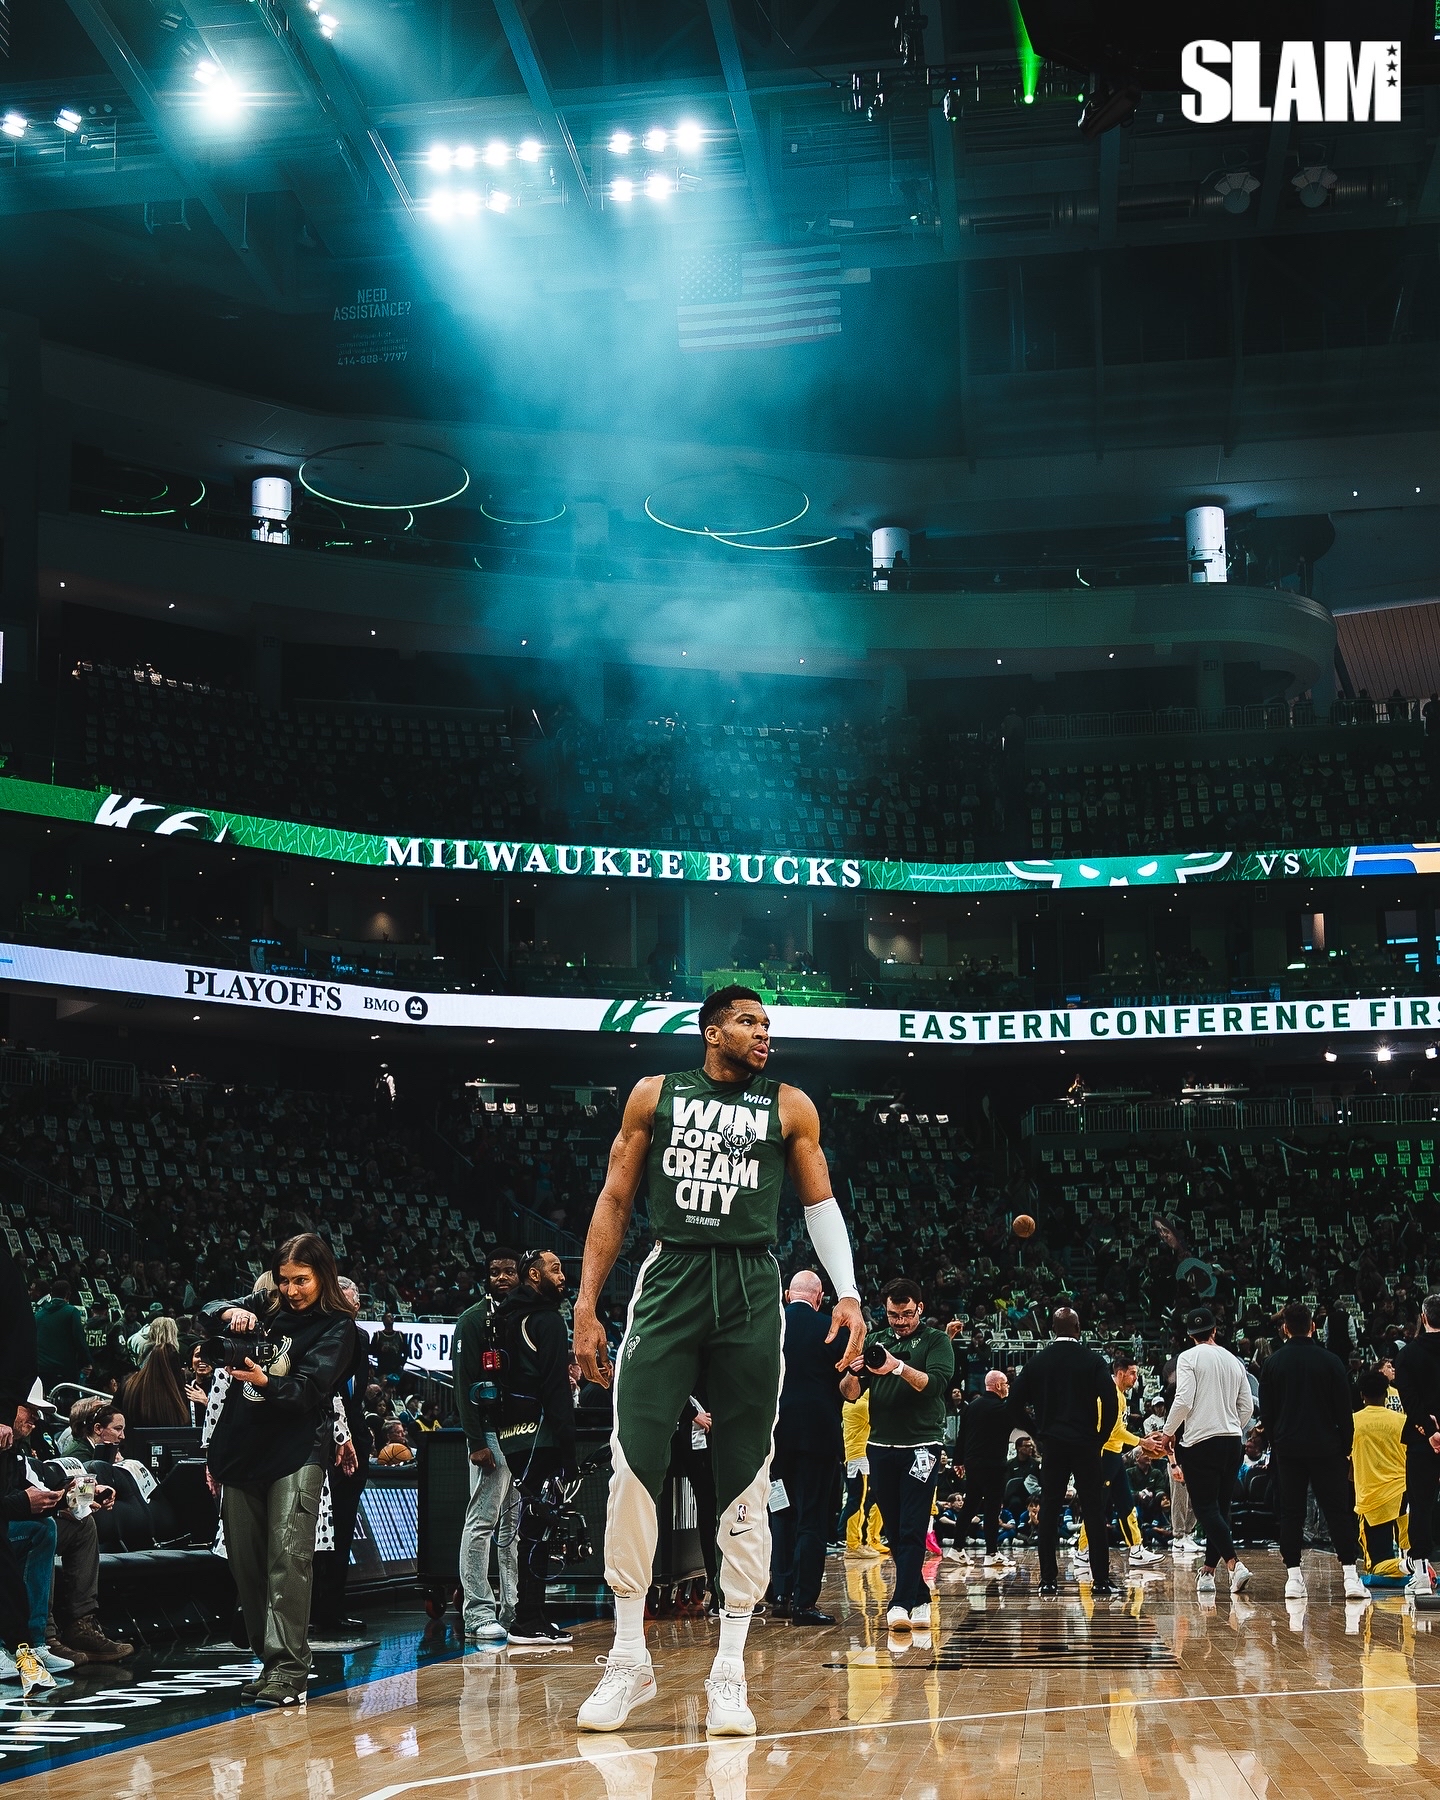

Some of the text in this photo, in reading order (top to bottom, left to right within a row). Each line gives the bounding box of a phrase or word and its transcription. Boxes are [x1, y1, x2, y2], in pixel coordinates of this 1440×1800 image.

[333, 301, 412, 321] ASSISTANCE?
[357, 287, 387, 304] NEED
[384, 836, 862, 888] MILWAUKEE BUCKS
[1255, 852, 1300, 876] VS
[184, 969, 342, 1011] PLAYOFFS
[363, 996, 400, 1013] BMO
[899, 1000, 1440, 1041] EASTERN CONFERENCE FIR
[673, 1096, 769, 1141] WIN
[670, 1126, 723, 1152] FOR
[662, 1147, 760, 1190] CREAM
[675, 1179, 739, 1215] CITY
